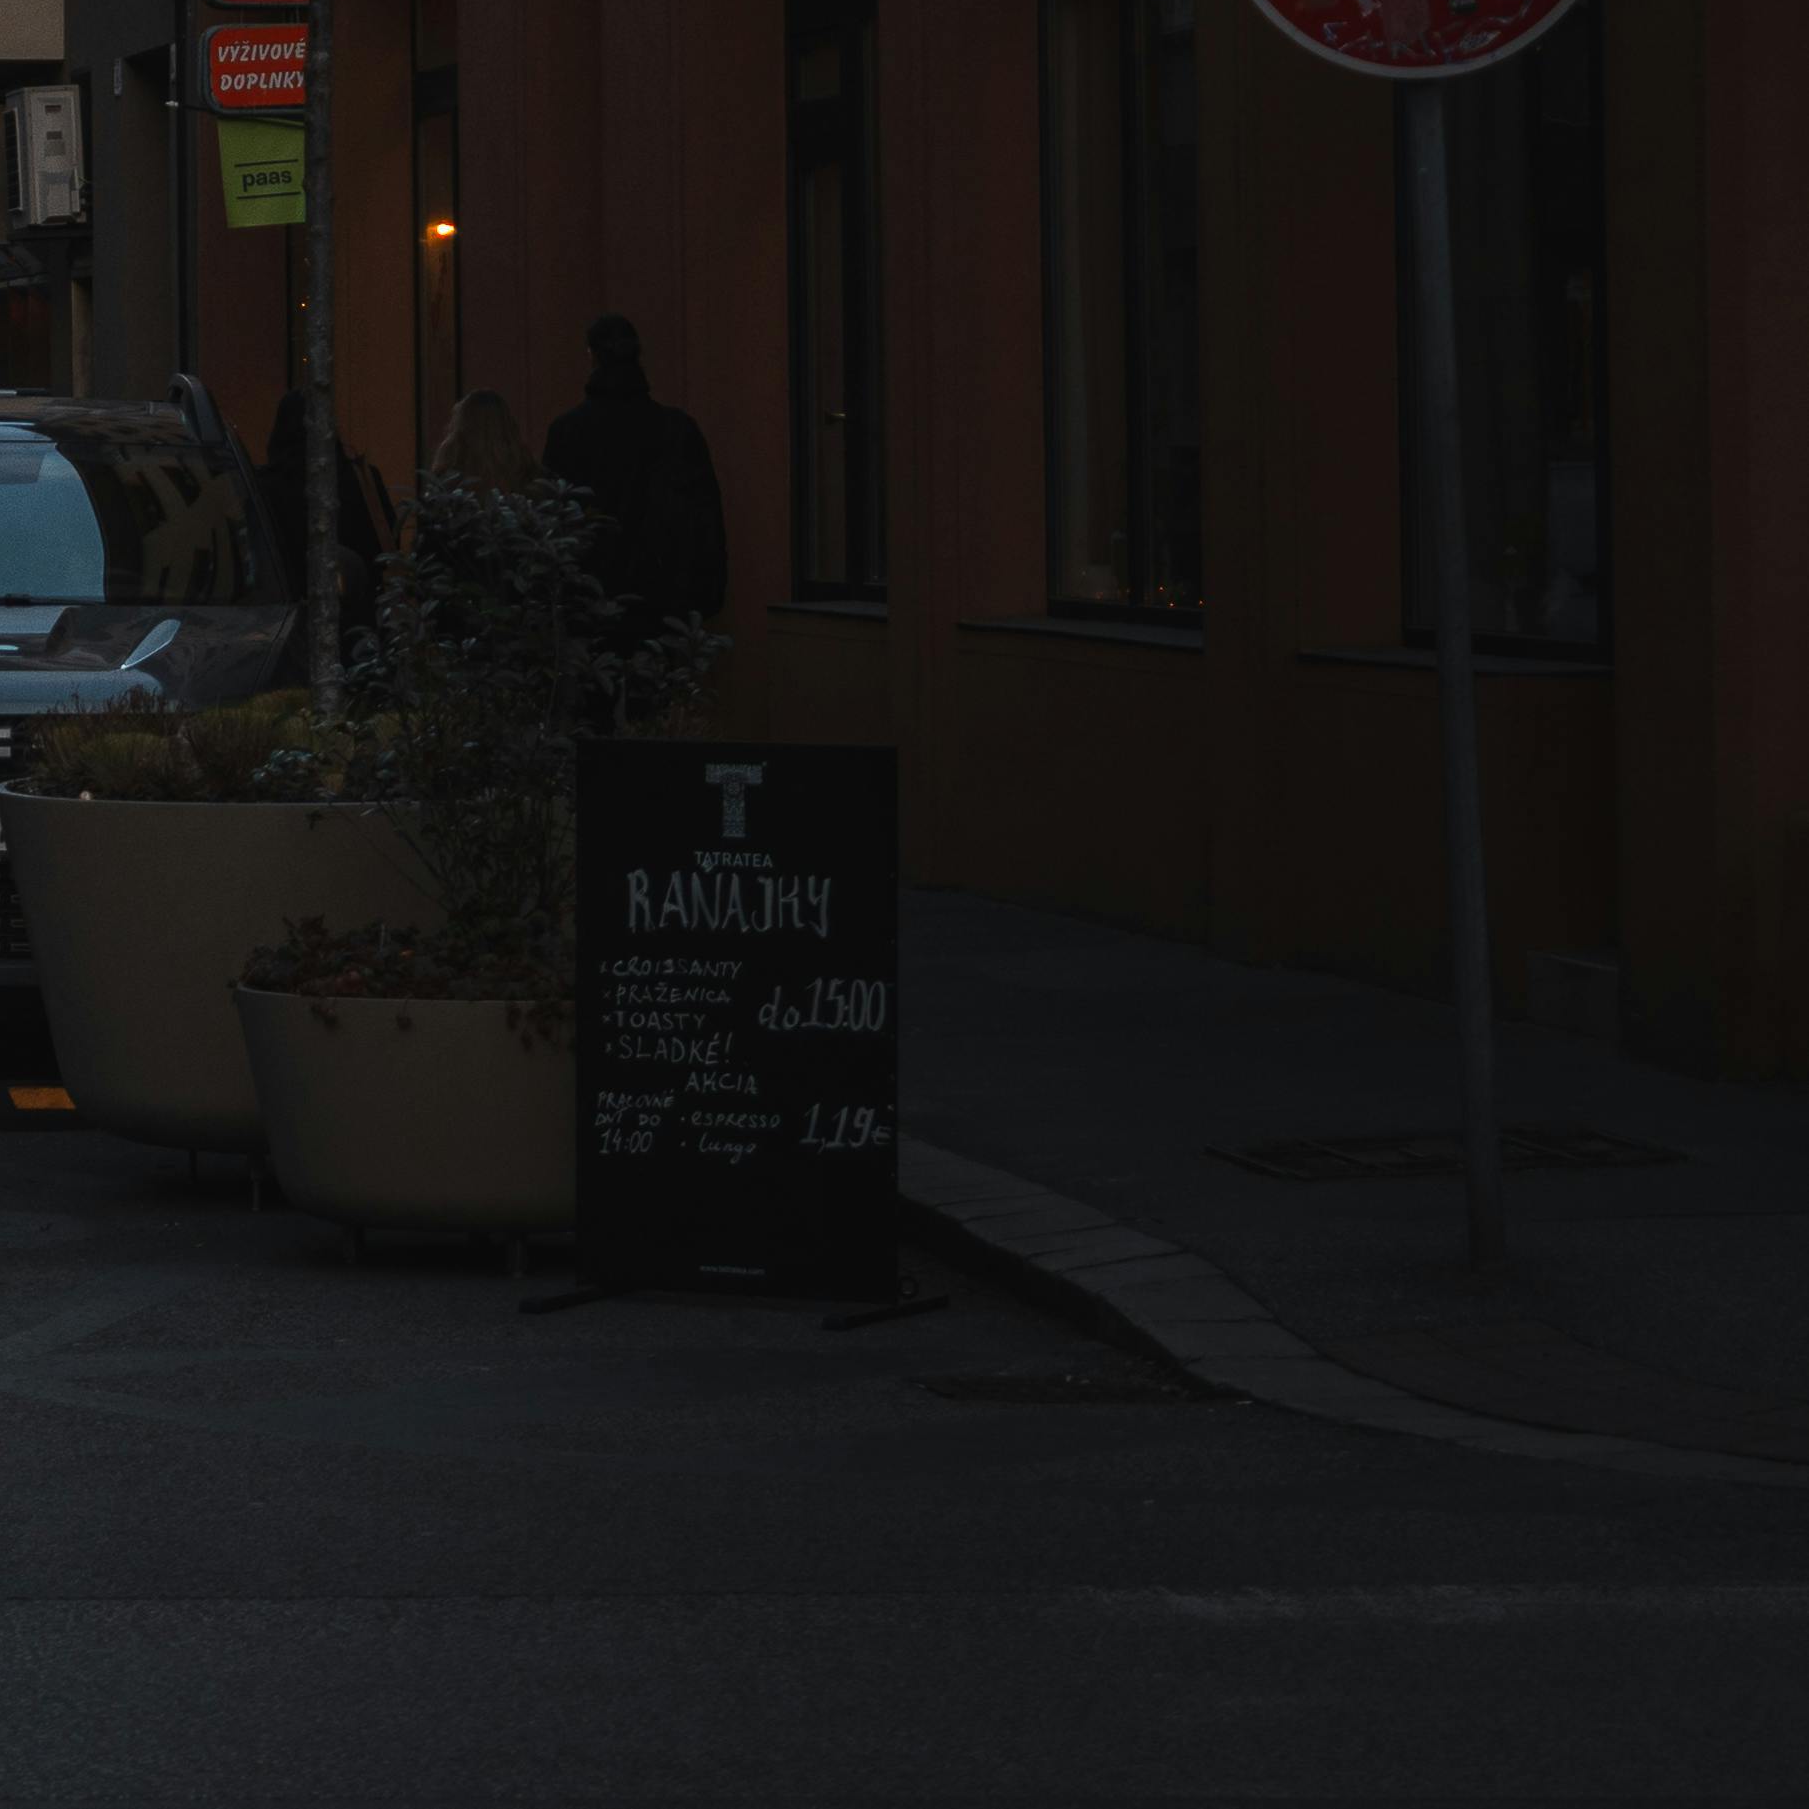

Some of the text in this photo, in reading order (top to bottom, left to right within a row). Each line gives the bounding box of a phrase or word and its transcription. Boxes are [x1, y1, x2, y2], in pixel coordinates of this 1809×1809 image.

[217, 38, 307, 63] VÝŽIVOVÉ
[220, 71, 306, 91] DOPLNKY
[242, 170, 293, 193] paas
[694, 851, 774, 869] TATRATEA
[615, 981, 732, 1006] PRAŽENICA
[614, 1010, 707, 1030] TOASTY
[684, 1072, 759, 1095] AKCIA
[598, 1128, 654, 1155] 14:00
